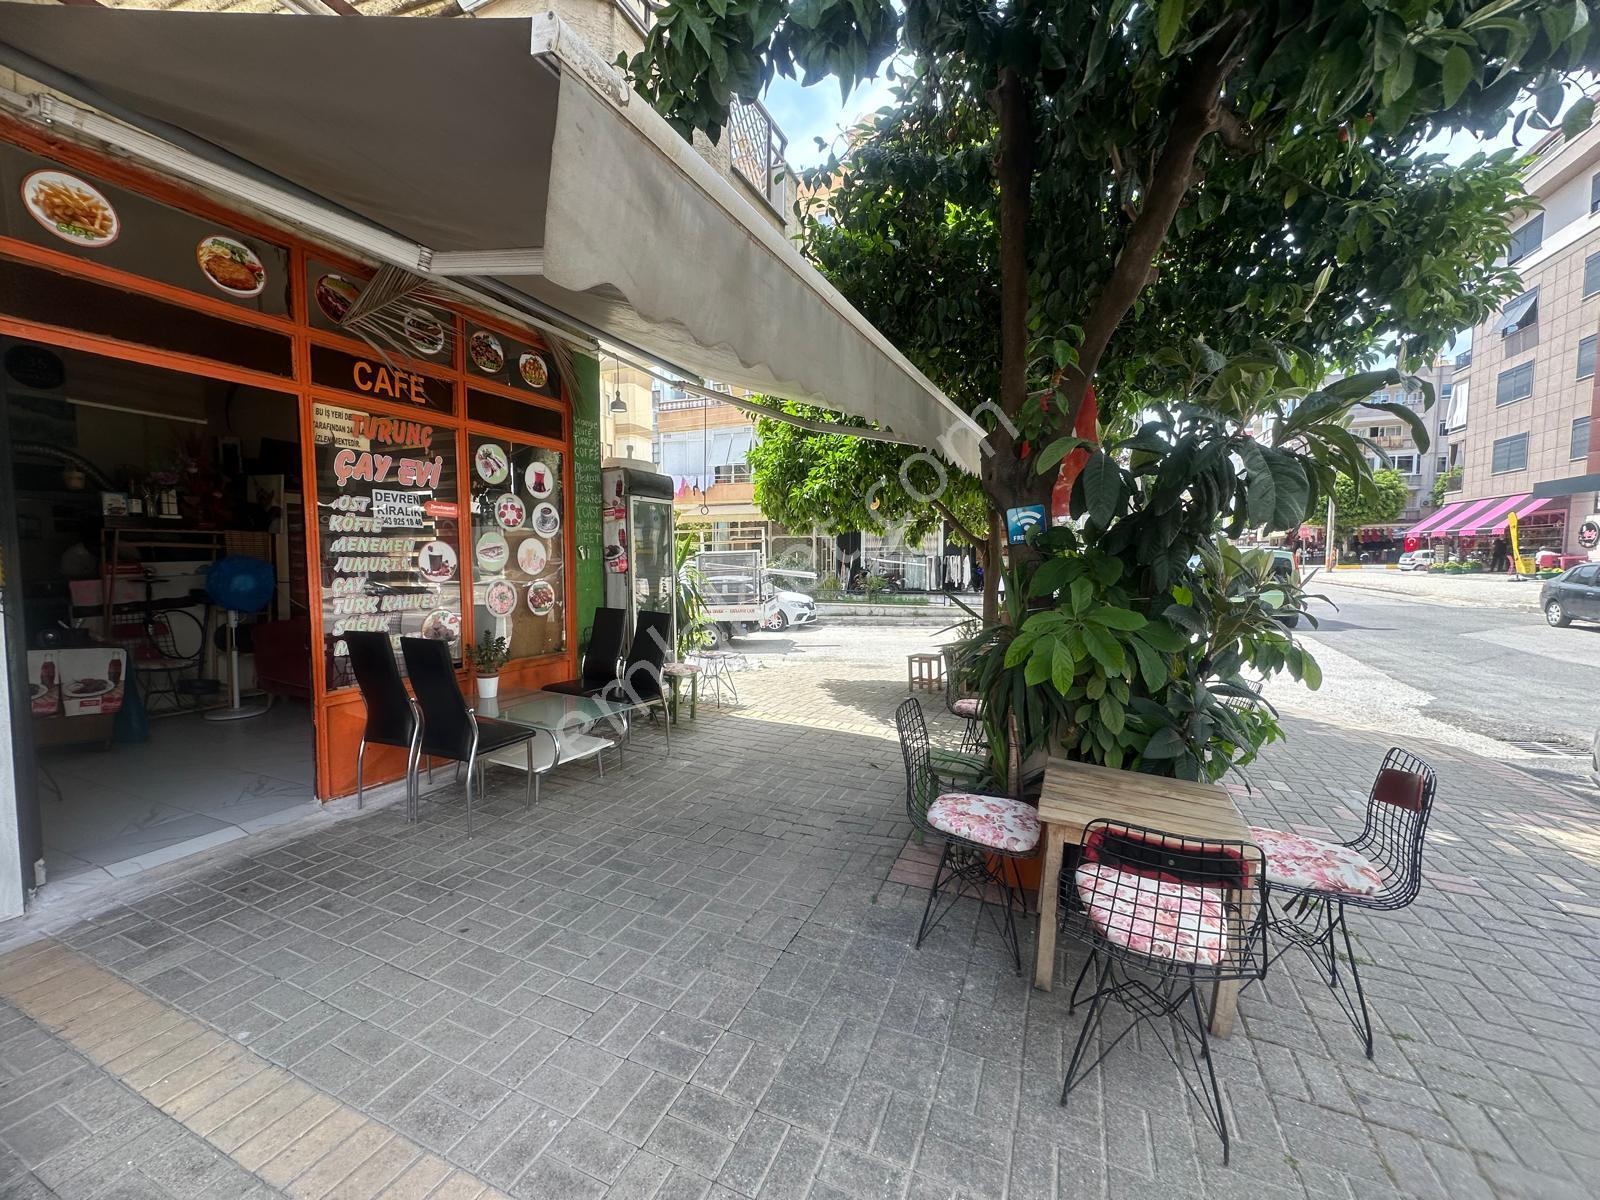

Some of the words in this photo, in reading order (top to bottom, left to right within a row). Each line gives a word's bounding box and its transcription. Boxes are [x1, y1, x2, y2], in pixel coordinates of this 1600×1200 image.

[353, 361, 426, 404] CAFE
[315, 407, 324, 416] BU
[334, 449, 392, 487] ÇAY
[398, 455, 443, 489] EVİ
[375, 491, 420, 505] DEVREN
[329, 512, 382, 533] KÖFTE
[330, 536, 416, 553] MENEMEN
[333, 593, 380, 615] TÜRK
